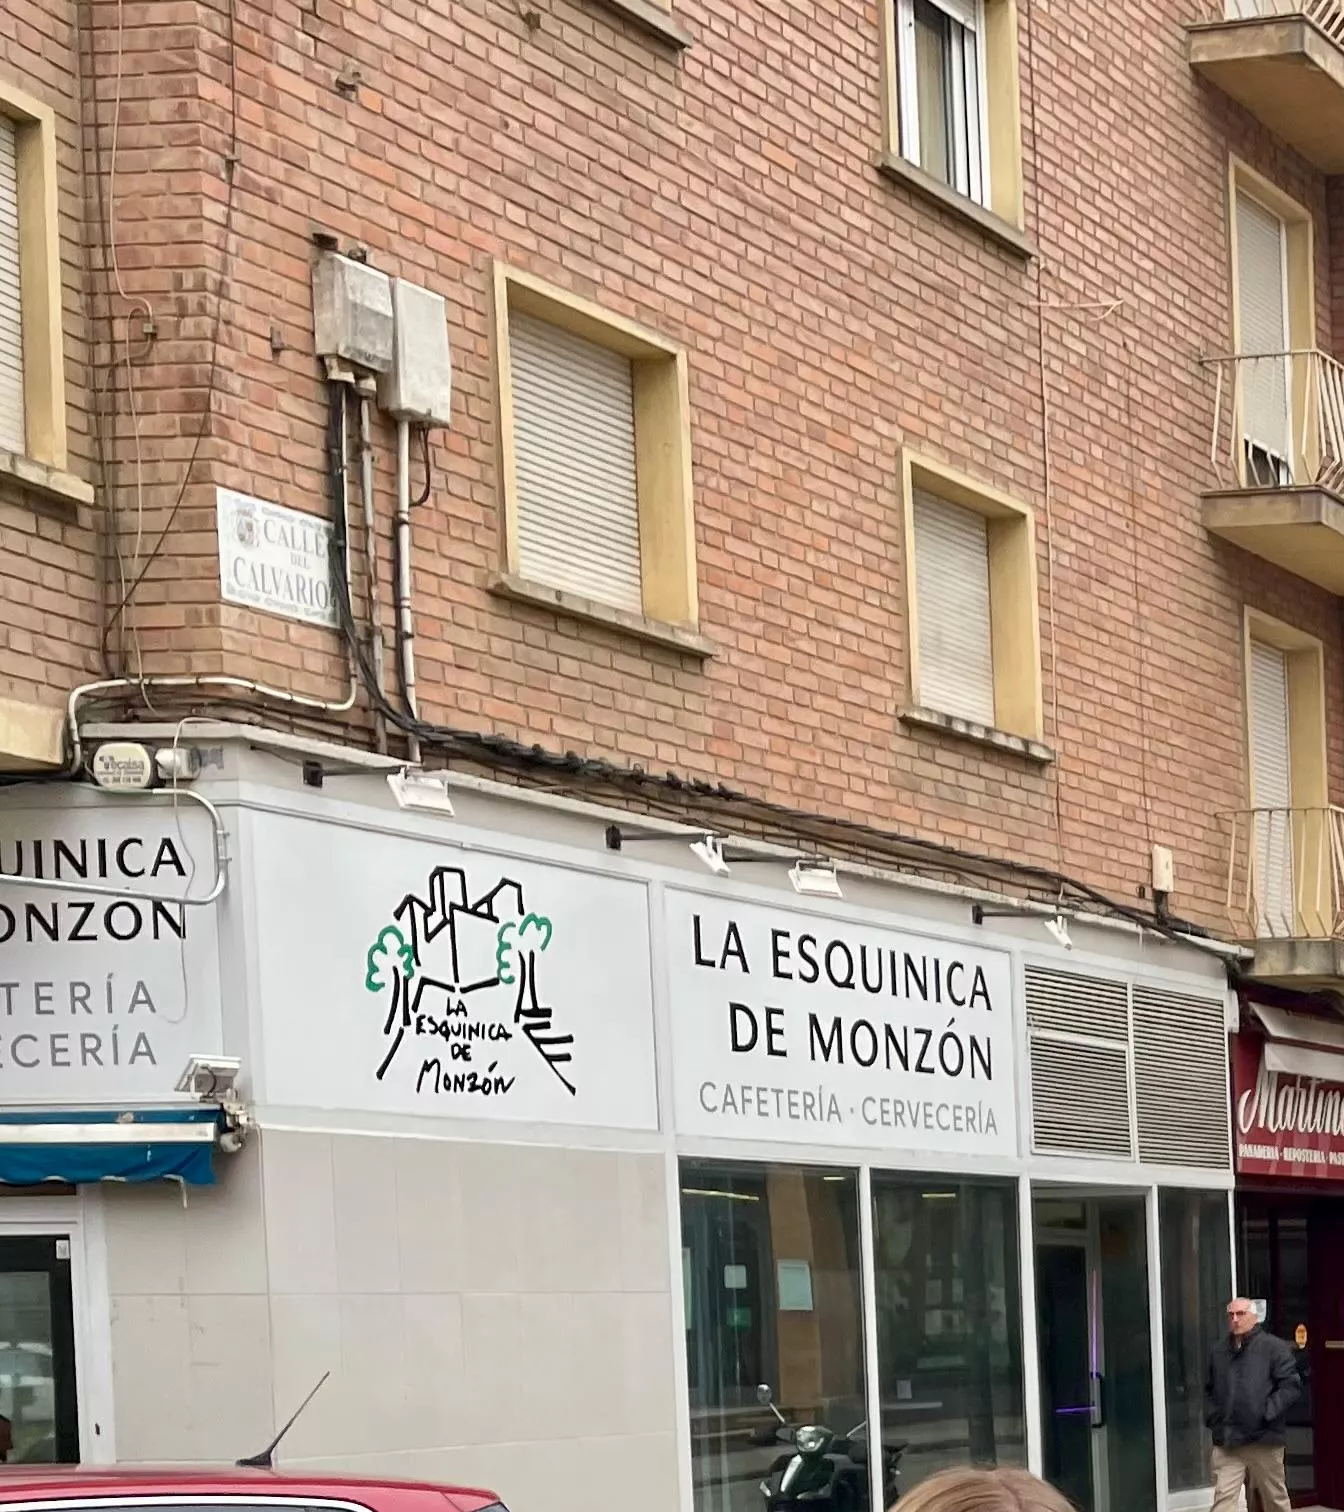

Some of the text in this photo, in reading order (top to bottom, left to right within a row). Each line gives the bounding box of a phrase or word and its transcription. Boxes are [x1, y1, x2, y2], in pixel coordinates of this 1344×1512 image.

[263, 519, 327, 559] CALLE
[290, 552, 310, 569] DEL
[233, 556, 328, 610] CALVARIO
[693, 914, 993, 1011] LA ESQUINICA
[446, 997, 468, 1018] LA
[416, 1014, 513, 1042] ESQUINICA
[729, 1001, 993, 1081] DE MONZÓN
[451, 1042, 472, 1062] DE
[699, 1081, 998, 1135] CAFETERÍA CERVECERÍA
